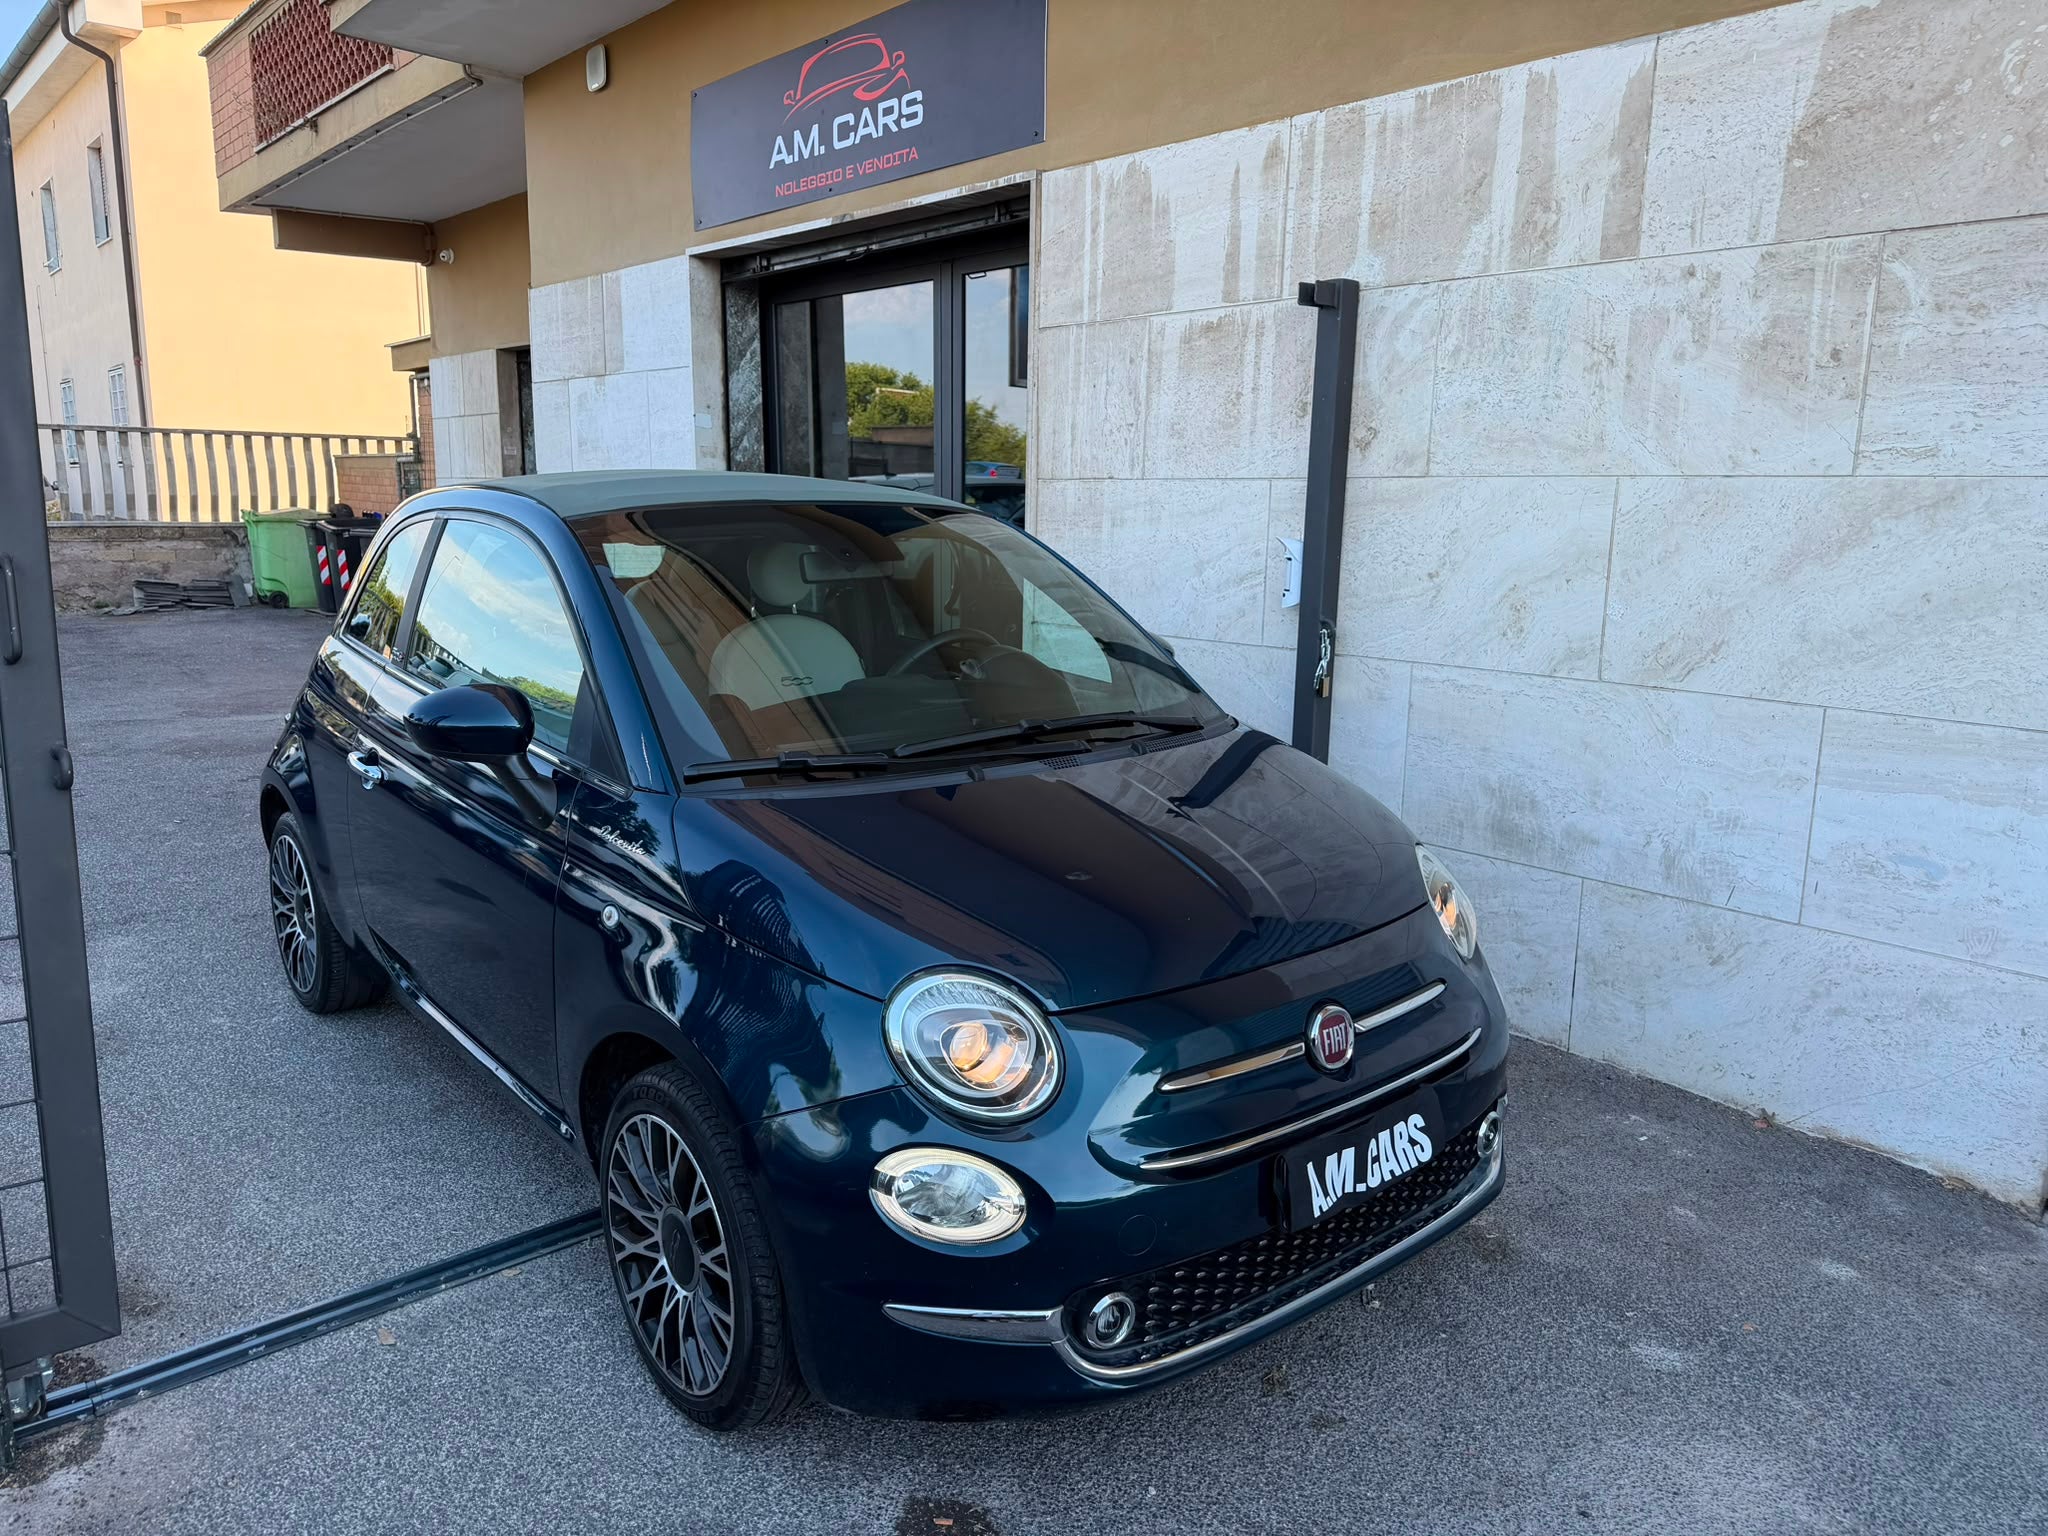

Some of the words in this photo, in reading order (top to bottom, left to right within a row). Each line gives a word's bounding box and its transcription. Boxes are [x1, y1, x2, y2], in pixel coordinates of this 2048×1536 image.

[769, 123, 826, 170] A.M.
[832, 90, 924, 150] CARS
[775, 168, 843, 198] NOLEGGIO
[846, 165, 855, 179] E
[857, 147, 919, 175] VENDITA
[1322, 1022, 1347, 1056] FIAT
